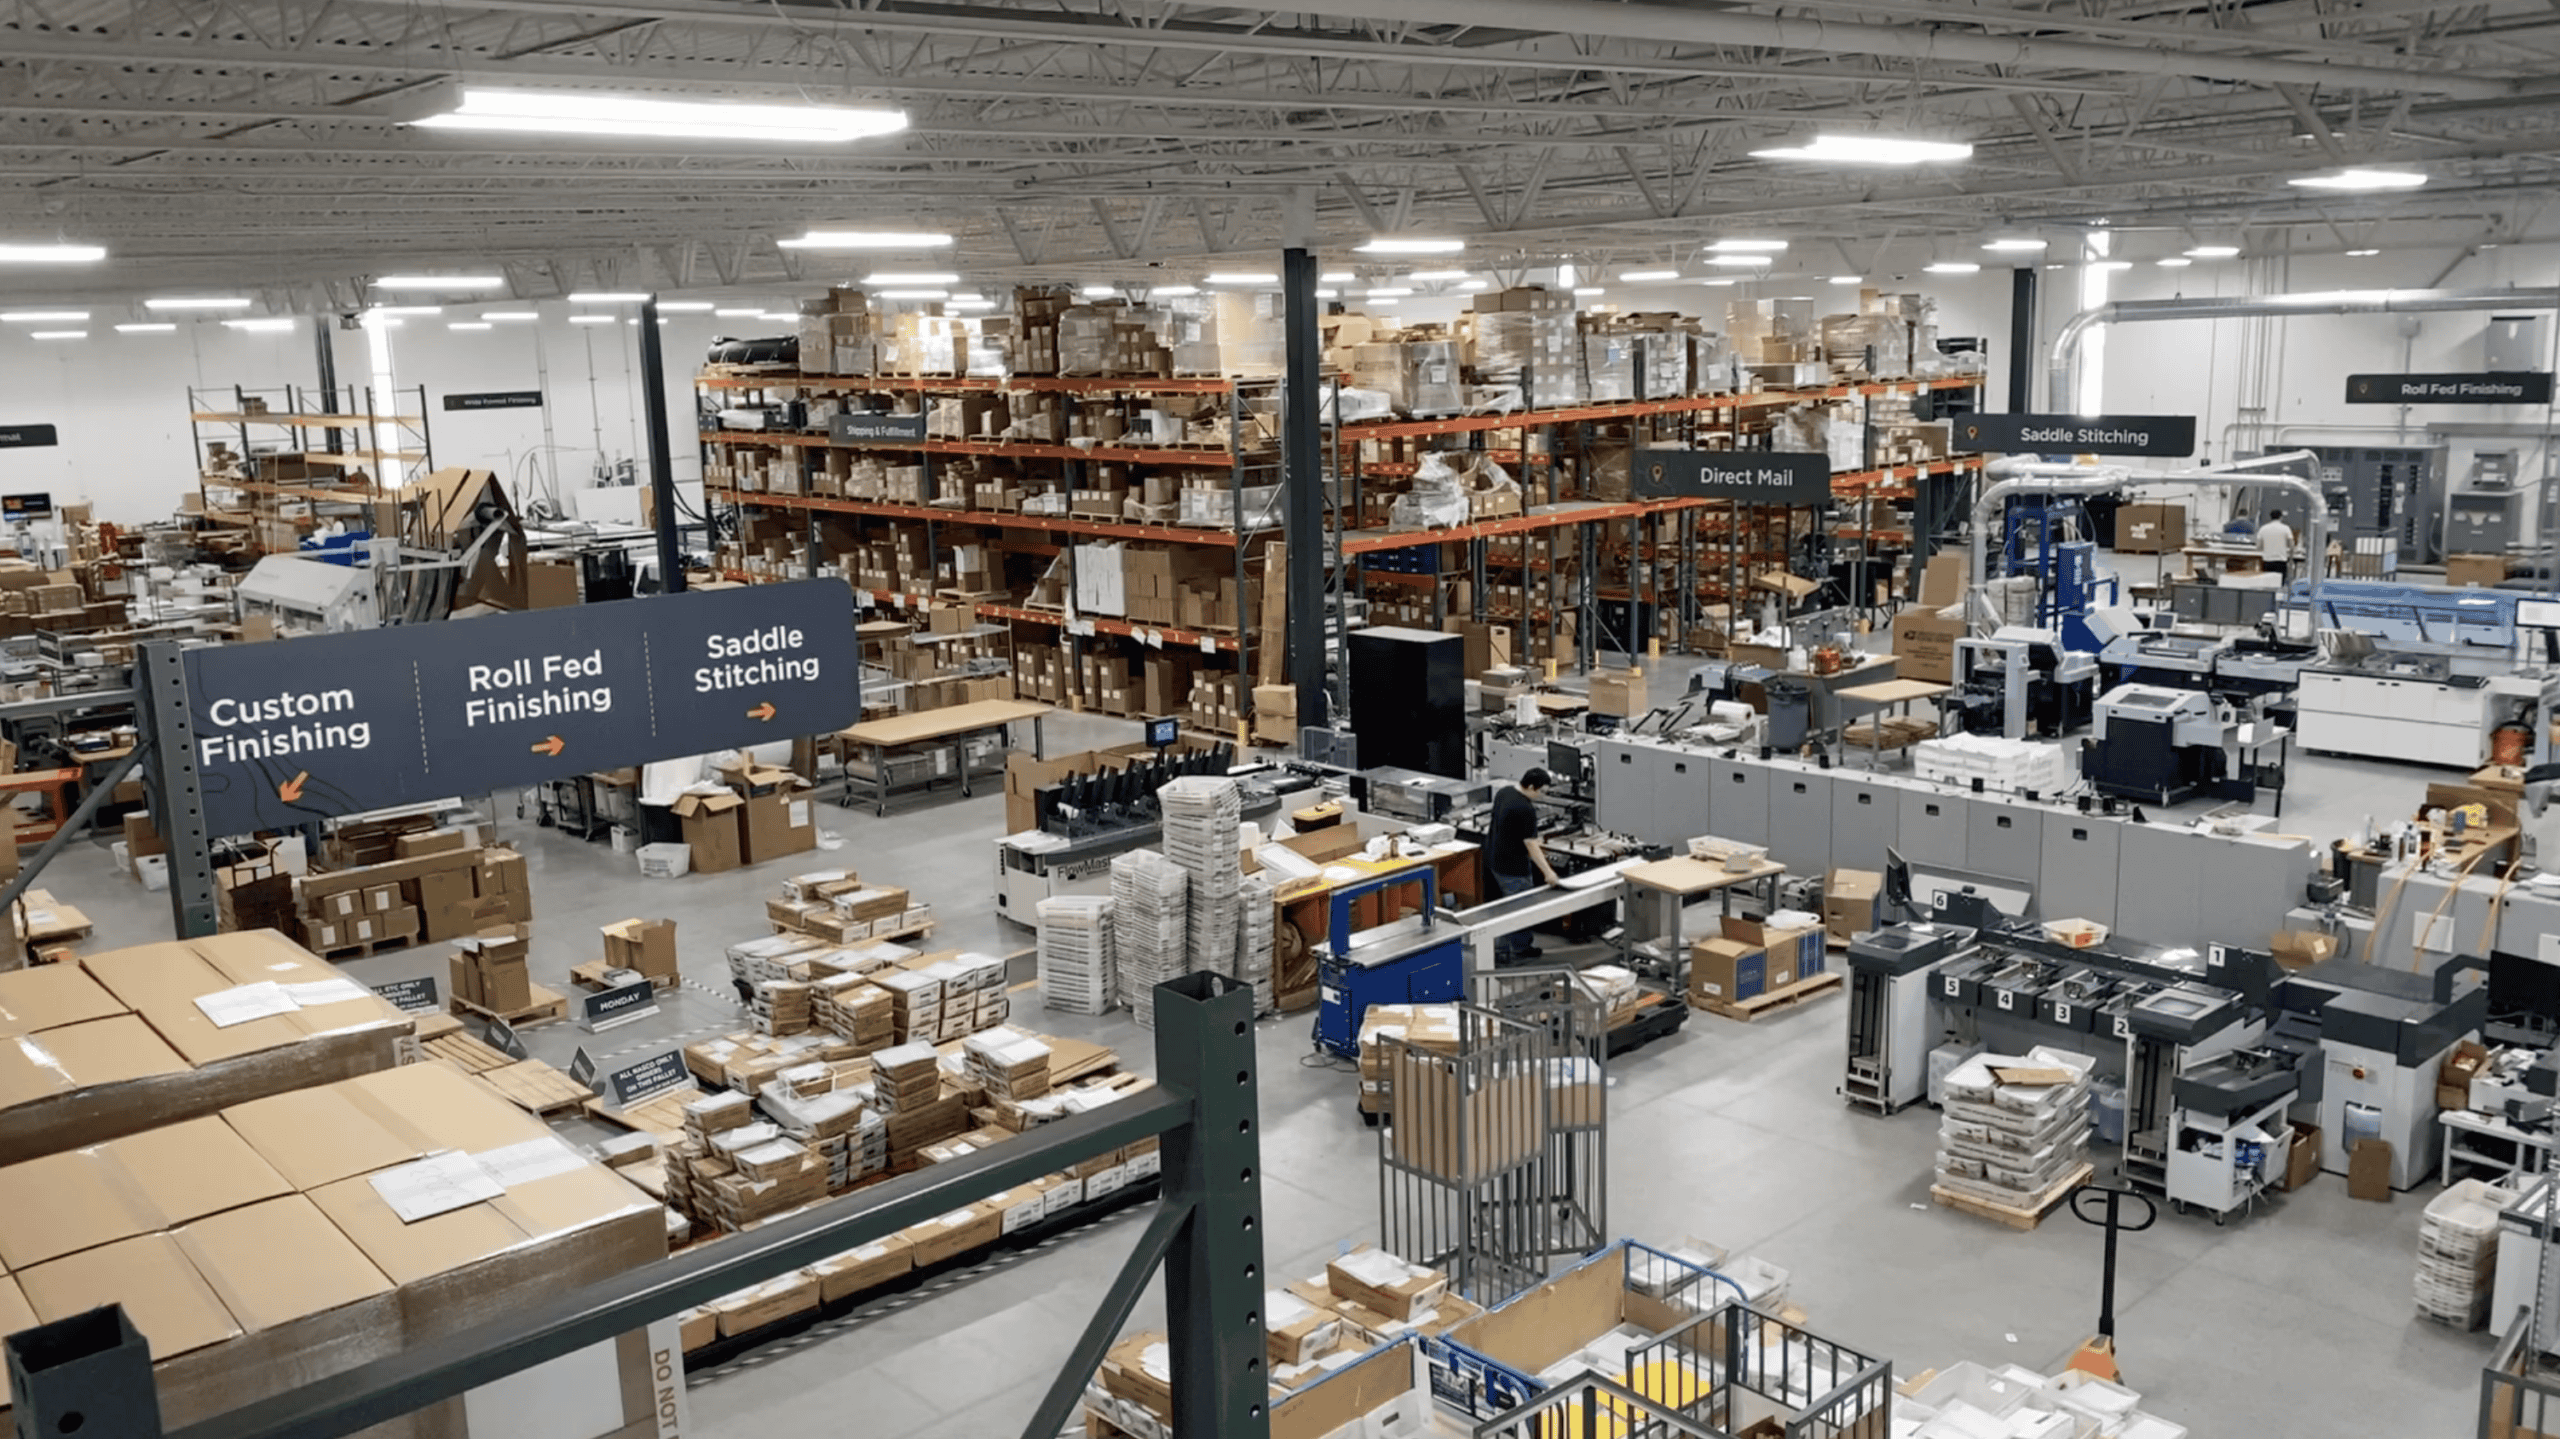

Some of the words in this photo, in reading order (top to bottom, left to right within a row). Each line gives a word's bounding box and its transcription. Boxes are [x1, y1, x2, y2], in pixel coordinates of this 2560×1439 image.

[2401, 383, 2427, 395] Roll
[2430, 383, 2457, 395] Fed
[2460, 383, 2523, 396] Finishing
[847, 425, 874, 438] Shipping
[875, 426, 880, 436] &
[881, 426, 916, 437] Fulfillment
[2020, 427, 2073, 442] Saddle
[2077, 428, 2149, 446] Stitching
[1700, 467, 1752, 486] Direct
[1758, 469, 1793, 487] Mail
[707, 625, 804, 660] Saddle
[469, 657, 533, 692] Roll
[542, 649, 602, 682] Fed
[694, 656, 820, 693] Stitching
[210, 689, 354, 726] Custom
[466, 685, 612, 727] Finishing
[201, 722, 370, 766] Finishing
[1936, 895, 1944, 907] 6
[2214, 950, 2221, 963] 1
[1949, 980, 1956, 992] 5
[600, 992, 640, 1011] MONDAY
[2000, 993, 2010, 1006] 4
[2059, 1007, 2067, 1020] 3
[2116, 1022, 2125, 1034] 2
[620, 1070, 633, 1079] ALL
[656, 1054, 673, 1066] ONLY
[653, 1068, 677, 1082] PALLET
[655, 1348, 672, 1382] DO
[658, 1387, 678, 1428] NOT
